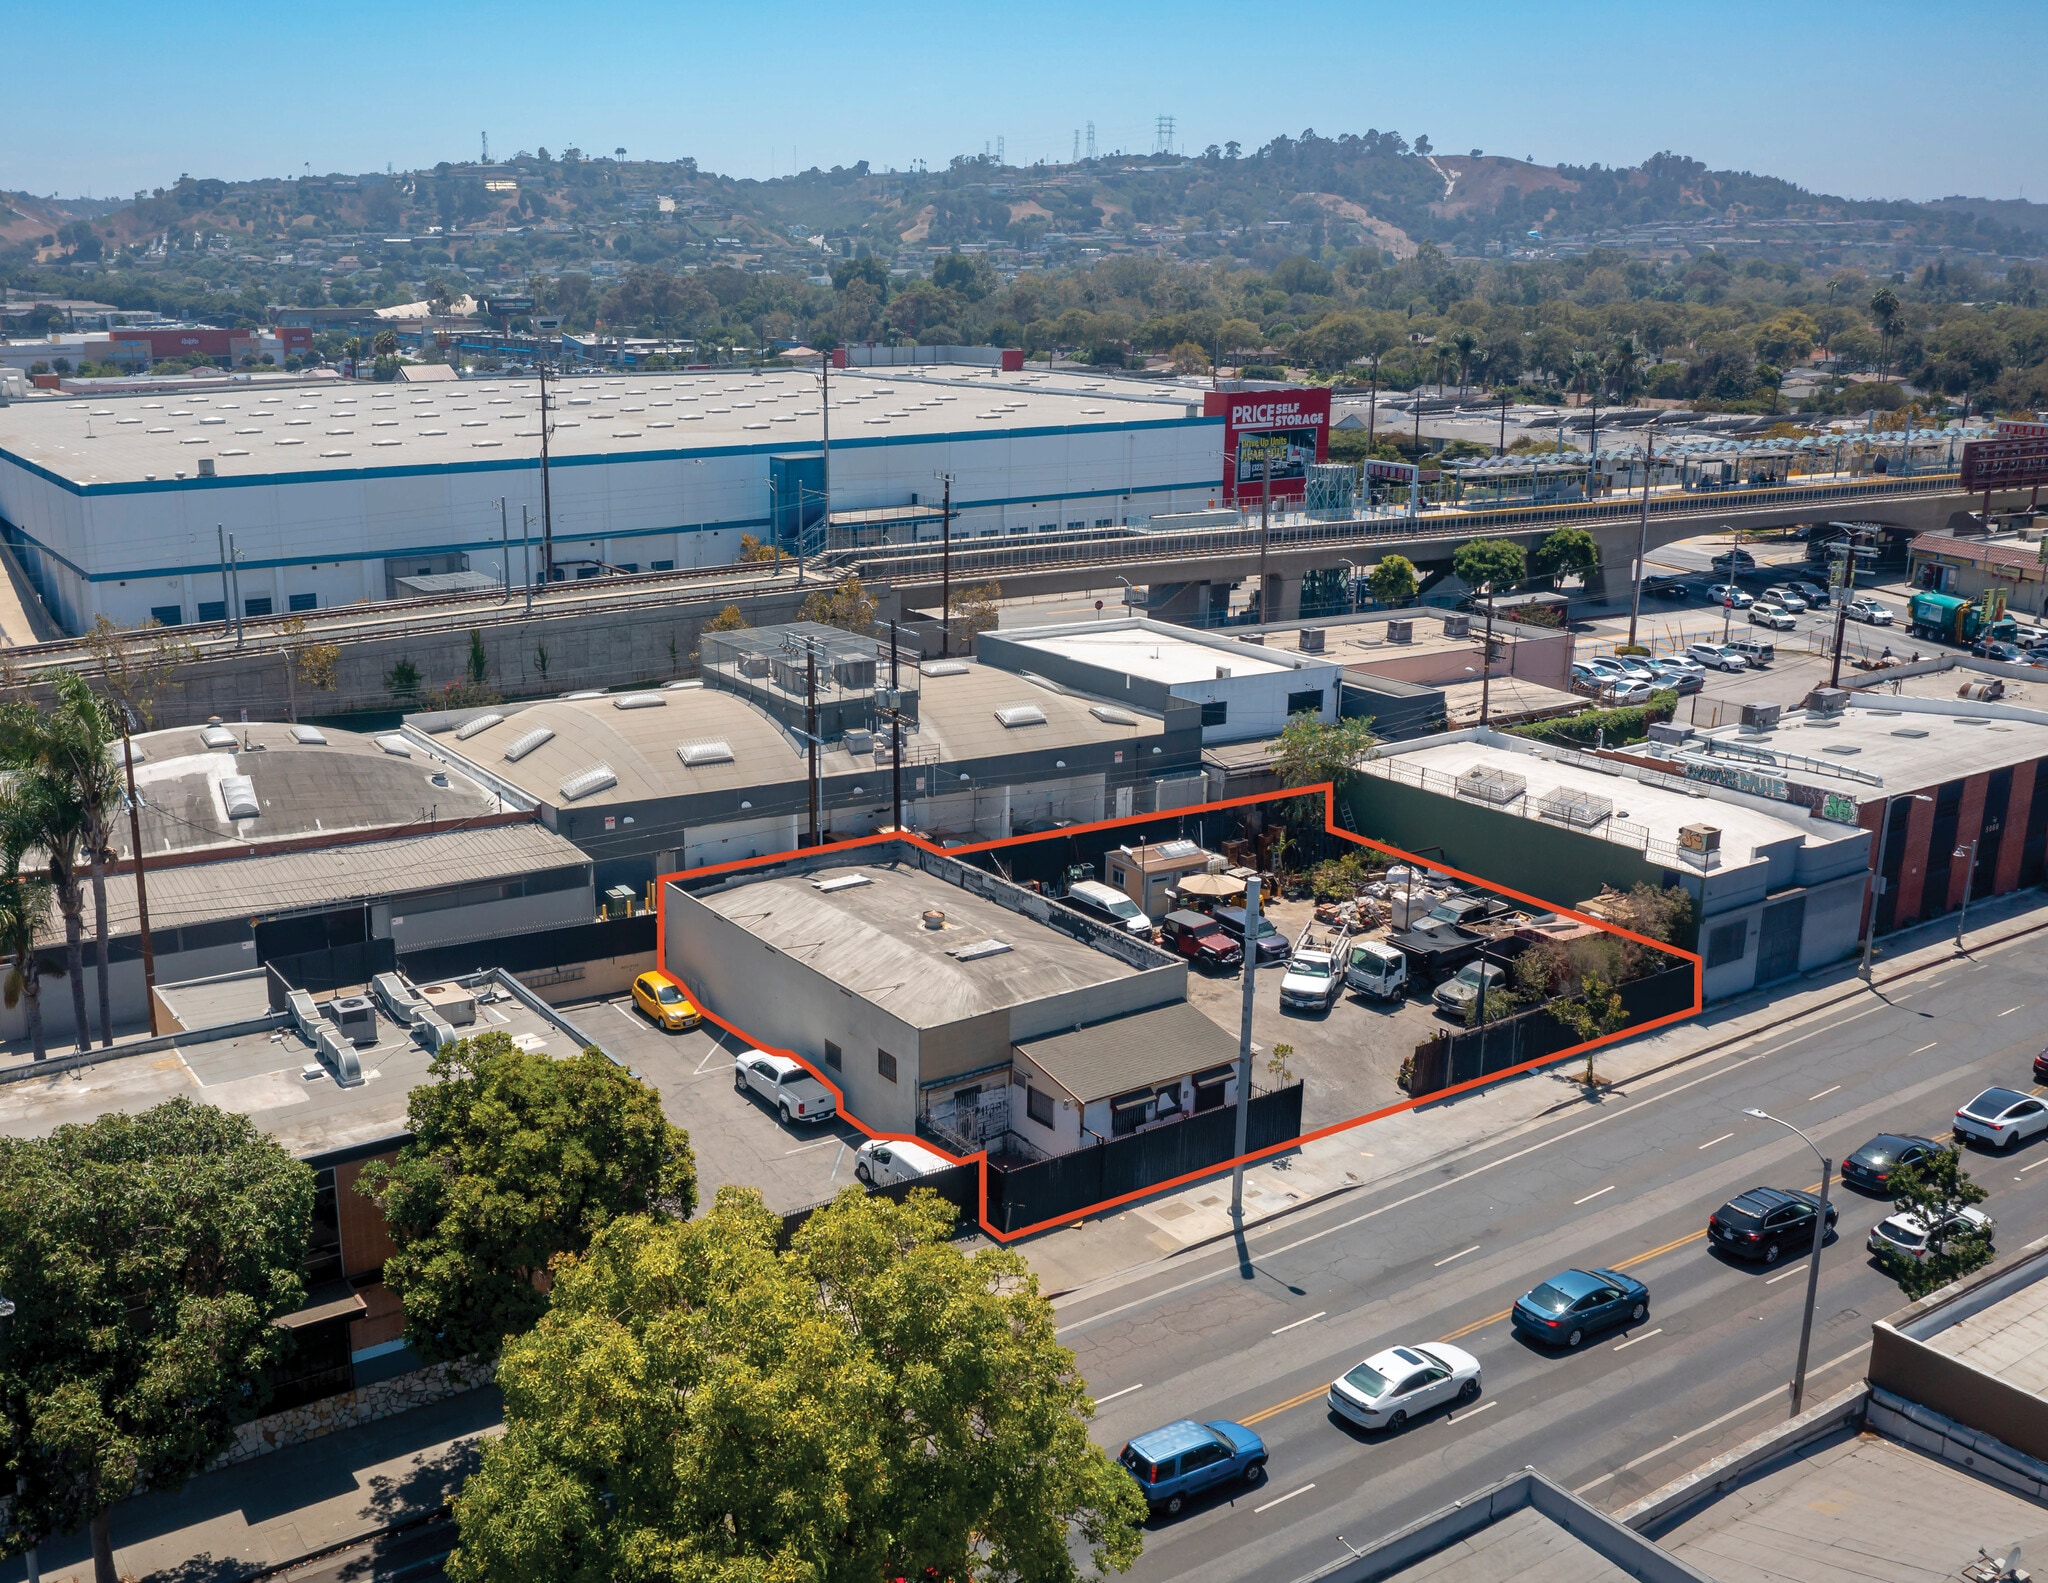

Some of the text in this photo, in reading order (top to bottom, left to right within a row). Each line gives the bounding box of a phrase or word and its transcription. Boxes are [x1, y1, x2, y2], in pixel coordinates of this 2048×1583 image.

[1232, 403, 1300, 423] PRICE SELF
[1275, 413, 1324, 426] STORAGE
[1241, 436, 1287, 448] Drive Up Units
[1980, 590, 1990, 623] HAMMER
